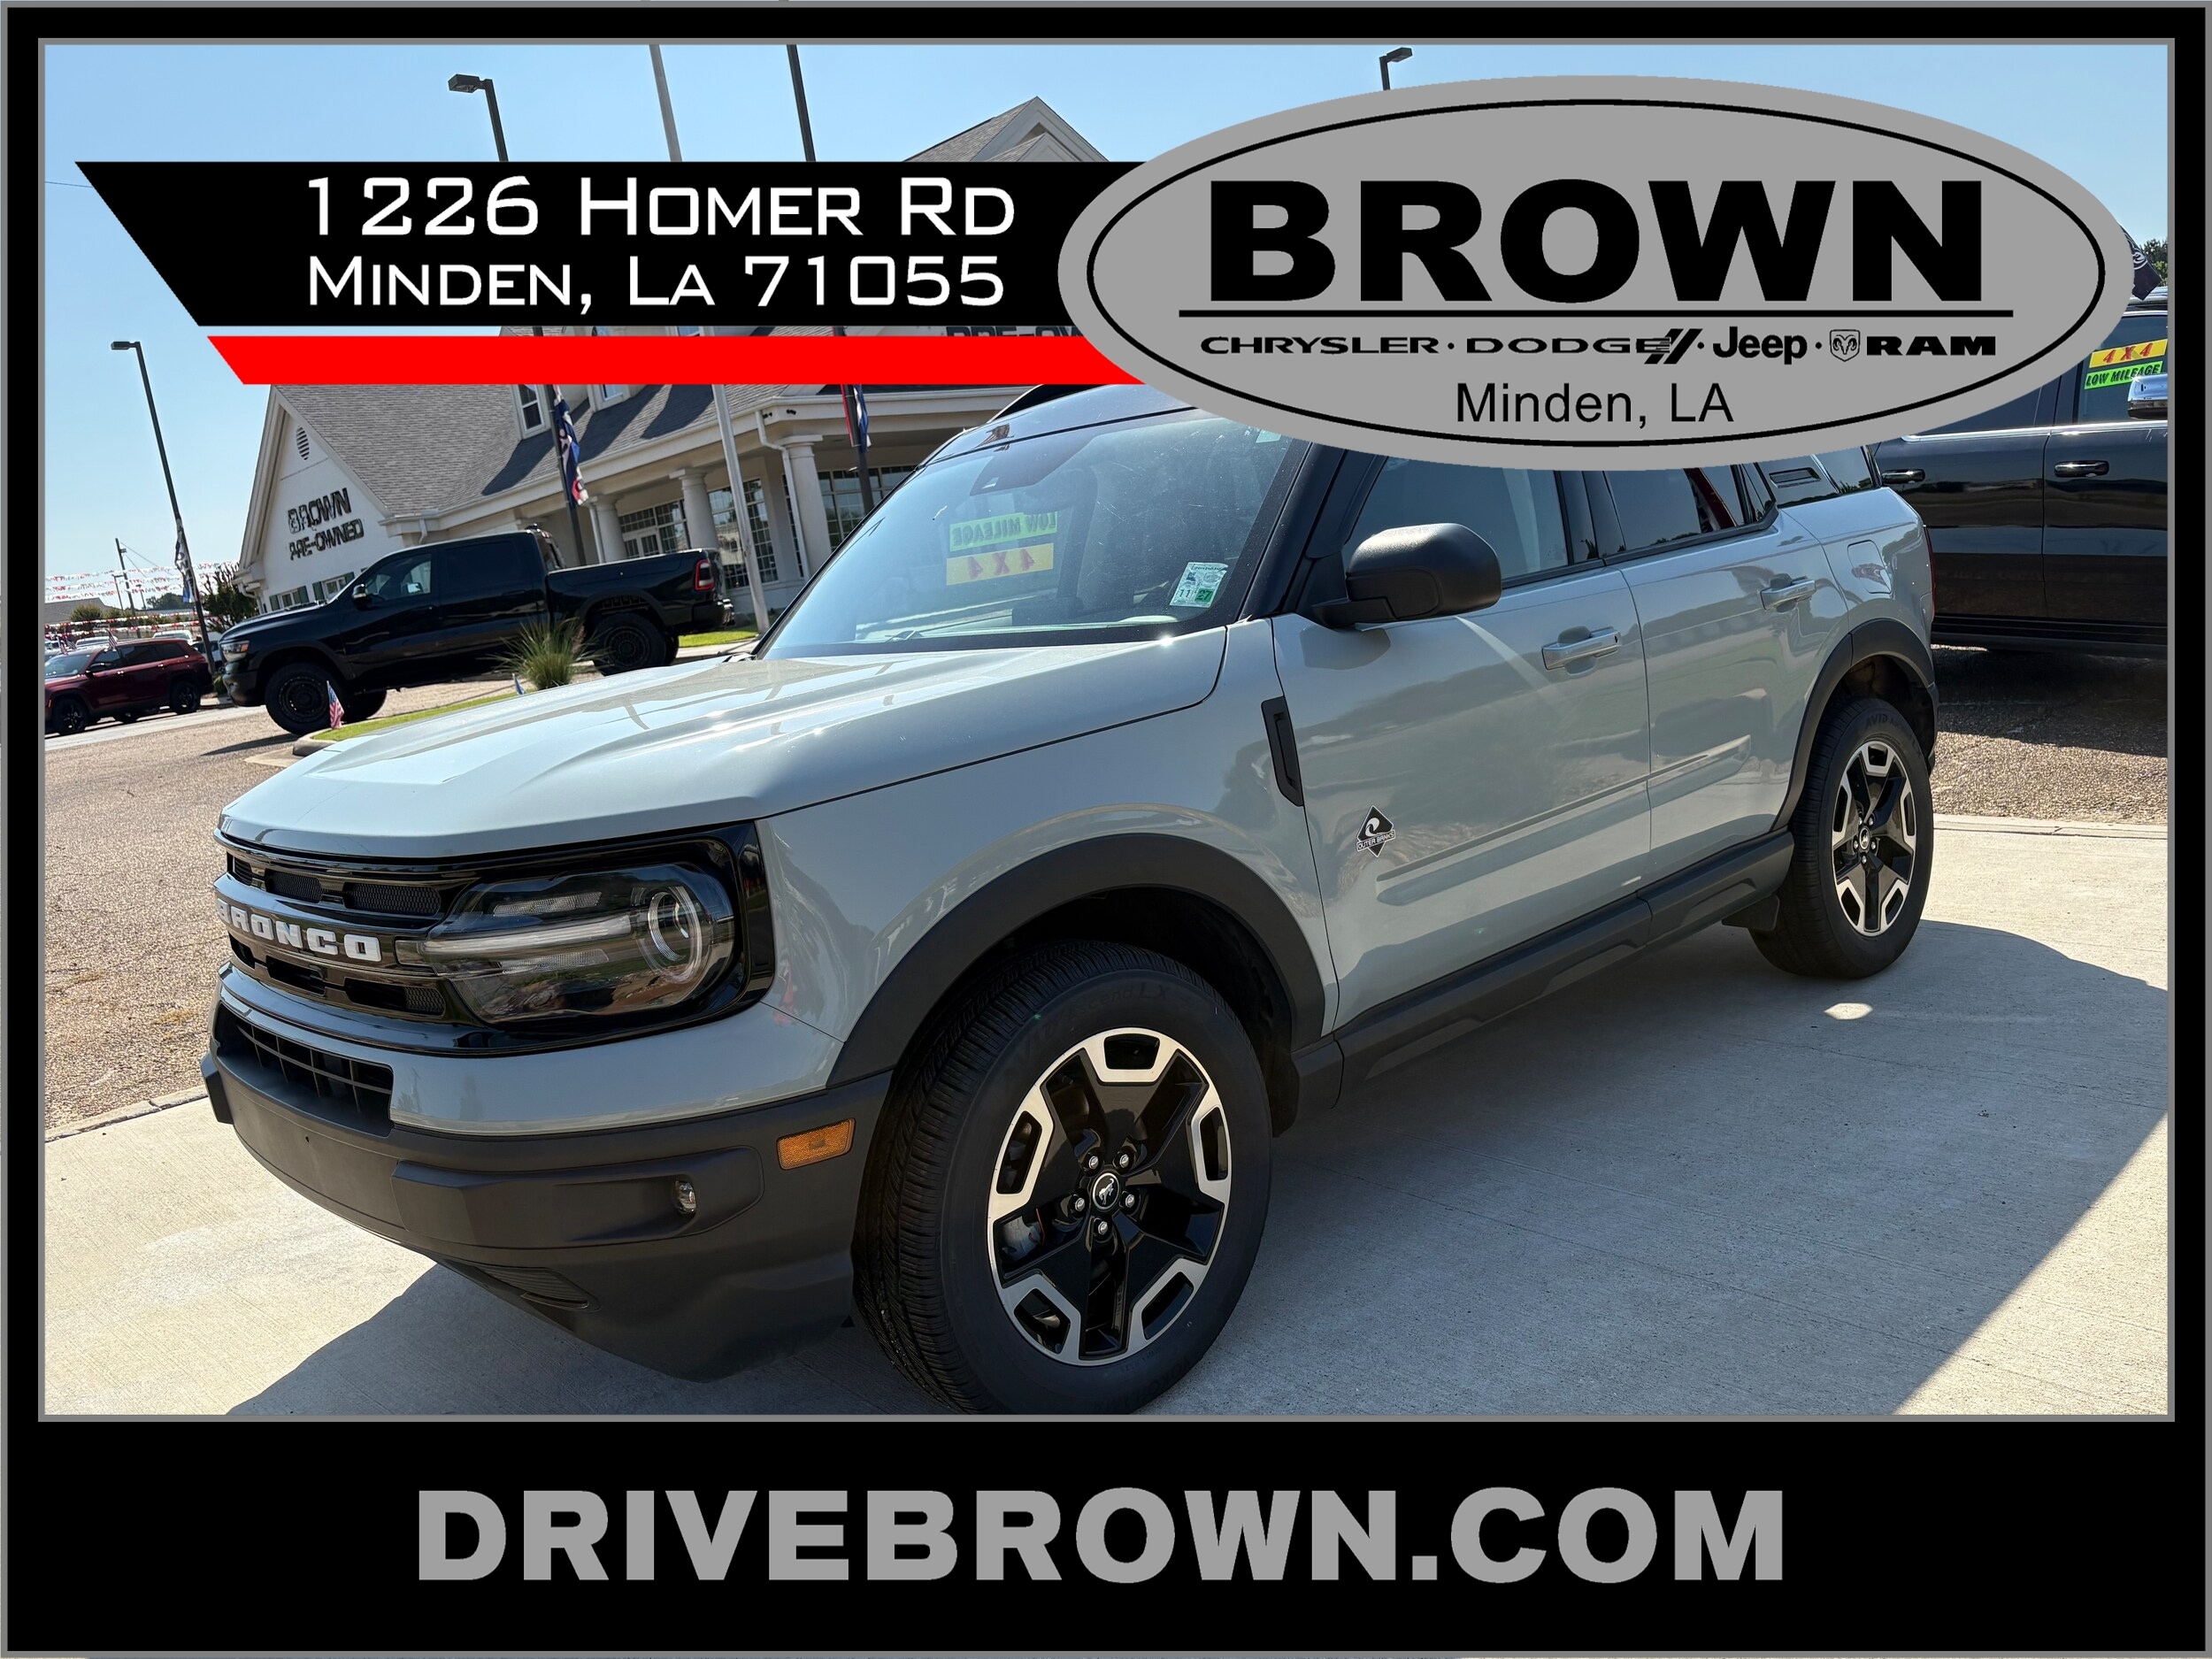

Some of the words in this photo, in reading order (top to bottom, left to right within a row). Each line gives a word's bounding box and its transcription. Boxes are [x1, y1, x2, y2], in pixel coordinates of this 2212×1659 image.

[2086, 373, 2109, 386] LOW
[2111, 365, 2161, 383] MILEAGE
[288, 488, 352, 534] BROWN
[288, 518, 365, 561] PRE-OWNED
[1197, 589, 1213, 600] 27
[1357, 838, 1376, 849] OUTER
[1376, 832, 1394, 843] BANKS
[218, 898, 382, 963] BRONCO
